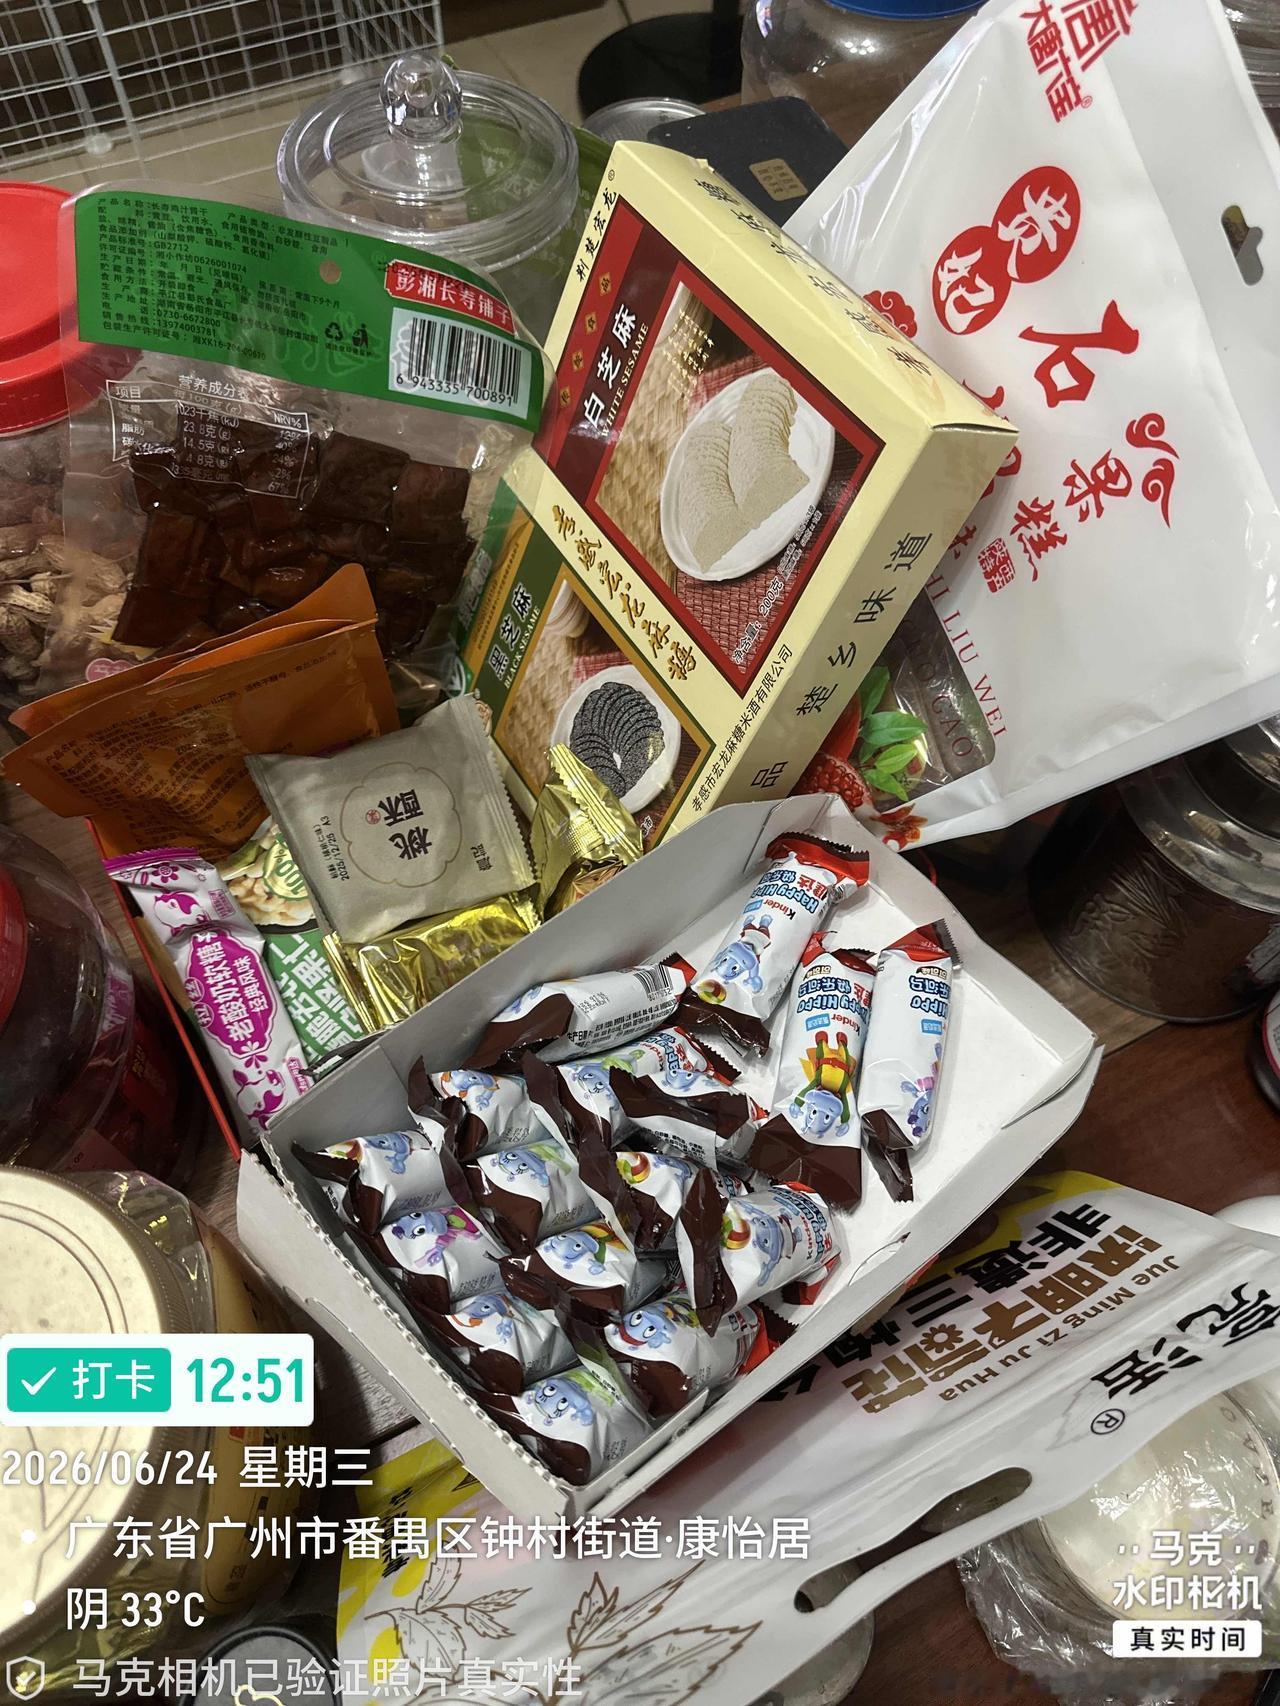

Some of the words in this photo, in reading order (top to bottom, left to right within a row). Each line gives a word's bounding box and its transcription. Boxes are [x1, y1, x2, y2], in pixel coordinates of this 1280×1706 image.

[1019, 1, 1083, 123] 大唐六宝
[575, 186, 617, 283] 荆楚宏龙
[395, 268, 511, 325] 彭湘长寿铺子
[115, 385, 142, 400] 项目
[178, 375, 249, 401] 营养成分表
[412, 375, 460, 395] 943335
[466, 385, 513, 408] 700891
[584, 304, 638, 427] 白芝麻
[600, 388, 625, 438] WHITE
[620, 322, 650, 389] SESAME
[488, 581, 533, 683] 黑芝麻
[503, 646, 525, 690] BLACK
[519, 607, 541, 650] SESAME
[733, 621, 763, 666] 净含量：
[759, 576, 784, 618] 200克
[751, 761, 789, 790] 品
[796, 532, 932, 719] 楚乡味道
[943, 610, 979, 664] LIU
[973, 674, 1009, 738] WEI
[691, 643, 793, 813] 孝感市宏龙麻糖米酒有限公司
[932, 693, 975, 758] GAO
[323, 815, 332, 827] A3
[377, 788, 432, 861] 桃酥
[197, 940, 254, 1042] 老酸奶软糖
[233, 955, 268, 1014] 经典风味
[797, 994, 842, 1014] Hippo
[798, 974, 852, 997] 快乐河马
[908, 974, 951, 998] 乐河马
[1132, 1254, 1181, 1289] Jue
[841, 1224, 1163, 1414] 决明子菊花
[1061, 1287, 1137, 1331] Ming
[940, 1365, 1000, 1403] Hua
[998, 1343, 1033, 1372] Ju
